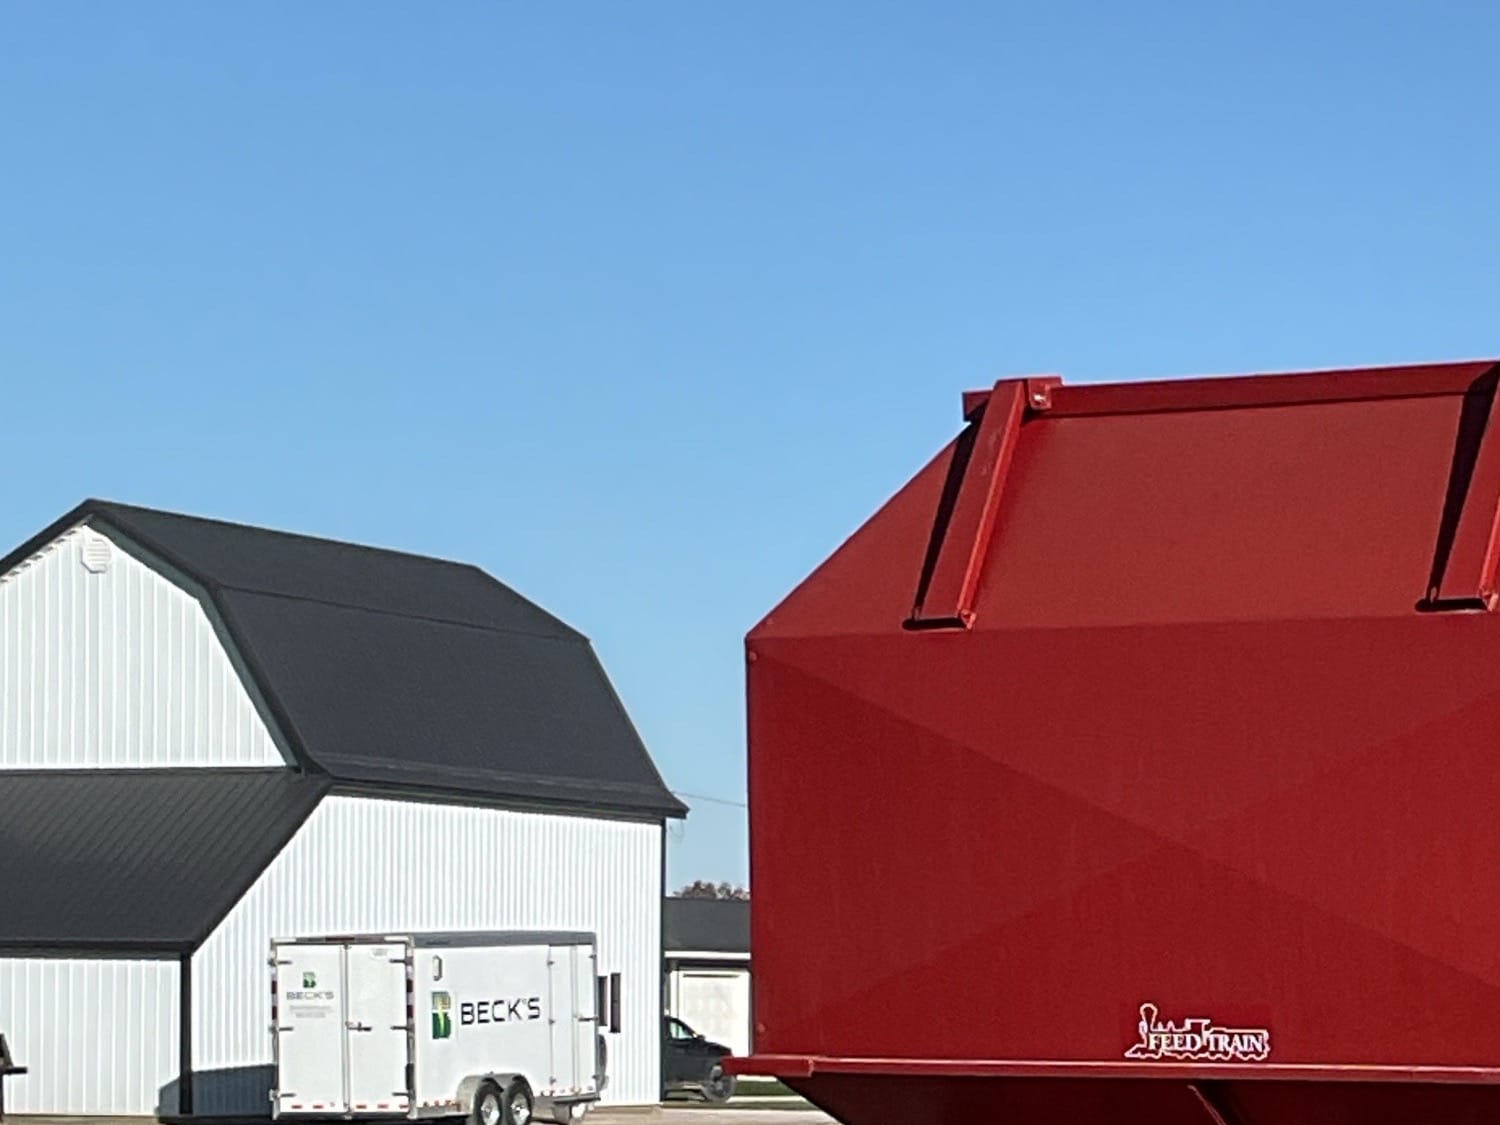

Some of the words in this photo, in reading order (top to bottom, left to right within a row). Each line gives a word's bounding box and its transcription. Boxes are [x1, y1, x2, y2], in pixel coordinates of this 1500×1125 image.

[461, 997, 541, 1025] BECK'S
[1149, 1033, 1200, 1052] FEED
[1208, 1034, 1263, 1053] TRAIN
